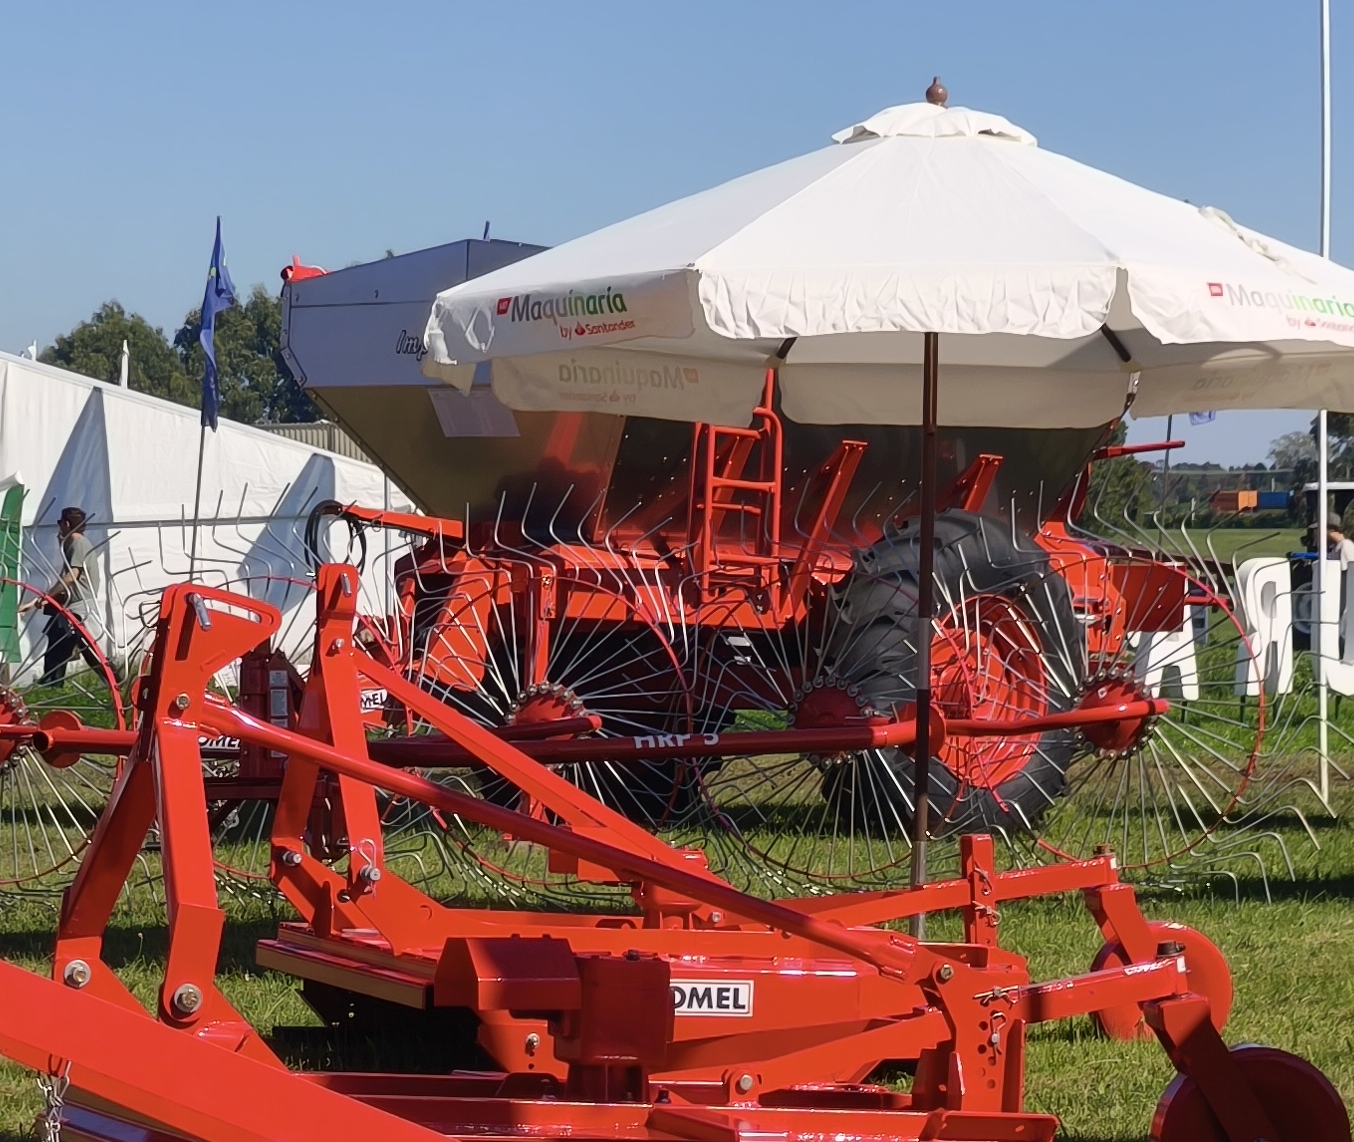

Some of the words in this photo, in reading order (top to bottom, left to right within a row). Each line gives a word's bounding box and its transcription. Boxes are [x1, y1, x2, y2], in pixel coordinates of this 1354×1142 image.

[511, 286, 628, 325] Maquinaria
[559, 324, 573, 340] by
[586, 319, 636, 336] Santander
[670, 986, 746, 1010] OMEL
